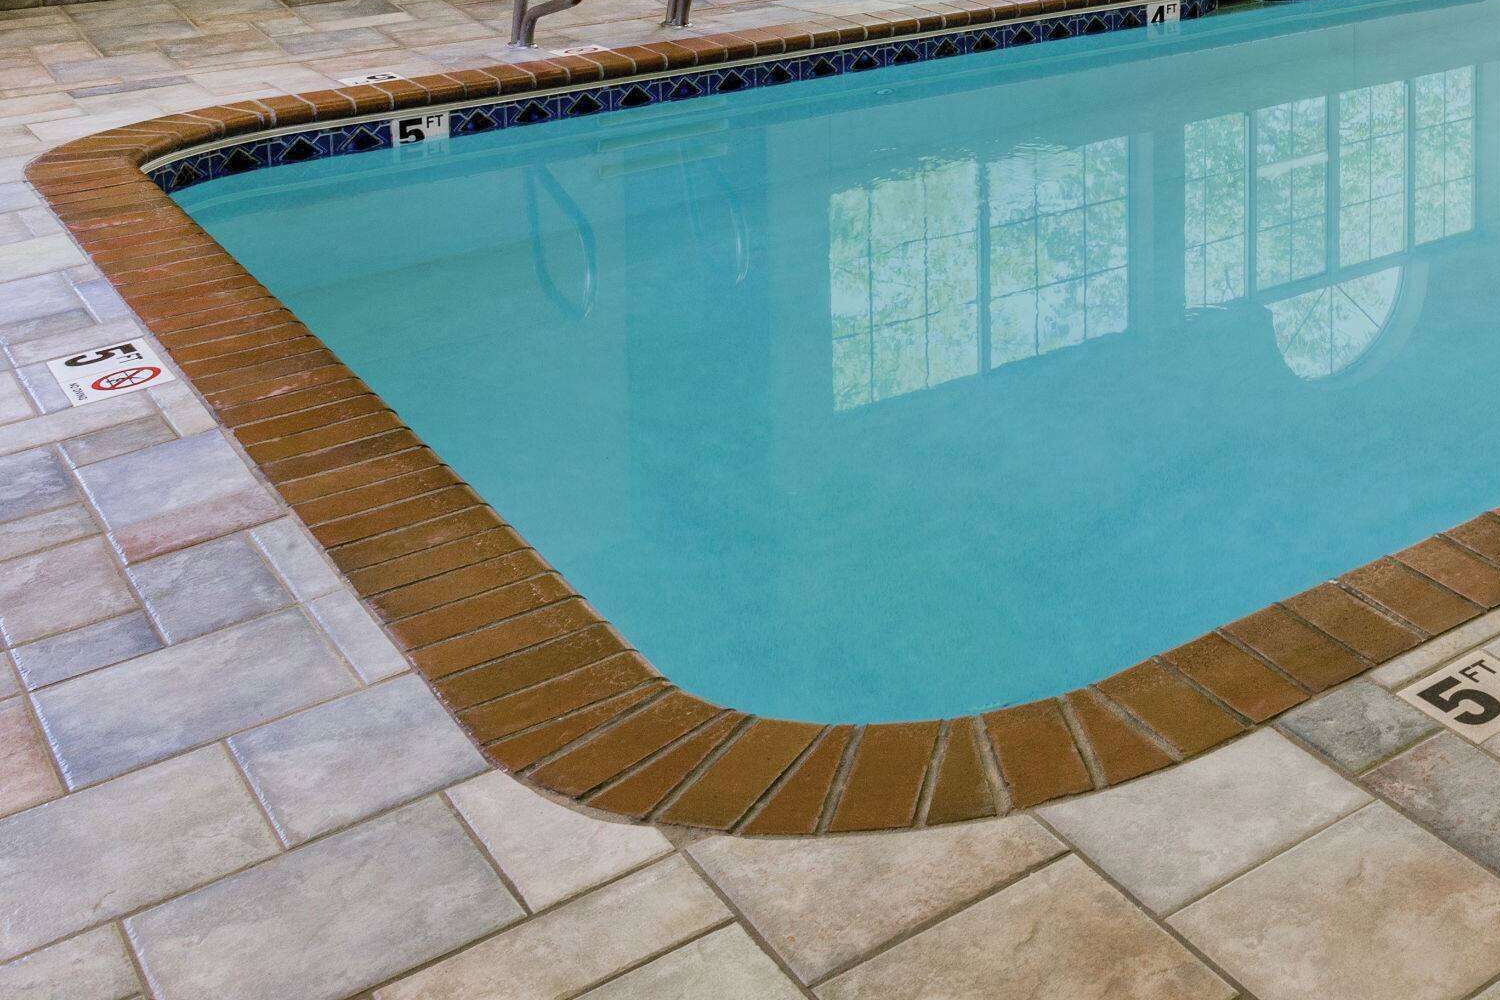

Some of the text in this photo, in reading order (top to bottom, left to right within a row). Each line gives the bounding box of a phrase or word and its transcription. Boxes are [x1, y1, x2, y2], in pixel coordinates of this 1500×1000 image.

[1151, 3, 1177, 23] 4 FT
[399, 114, 443, 144] 5 FT
[65, 343, 144, 367] 5 FT
[1458, 659, 1497, 683] FT
